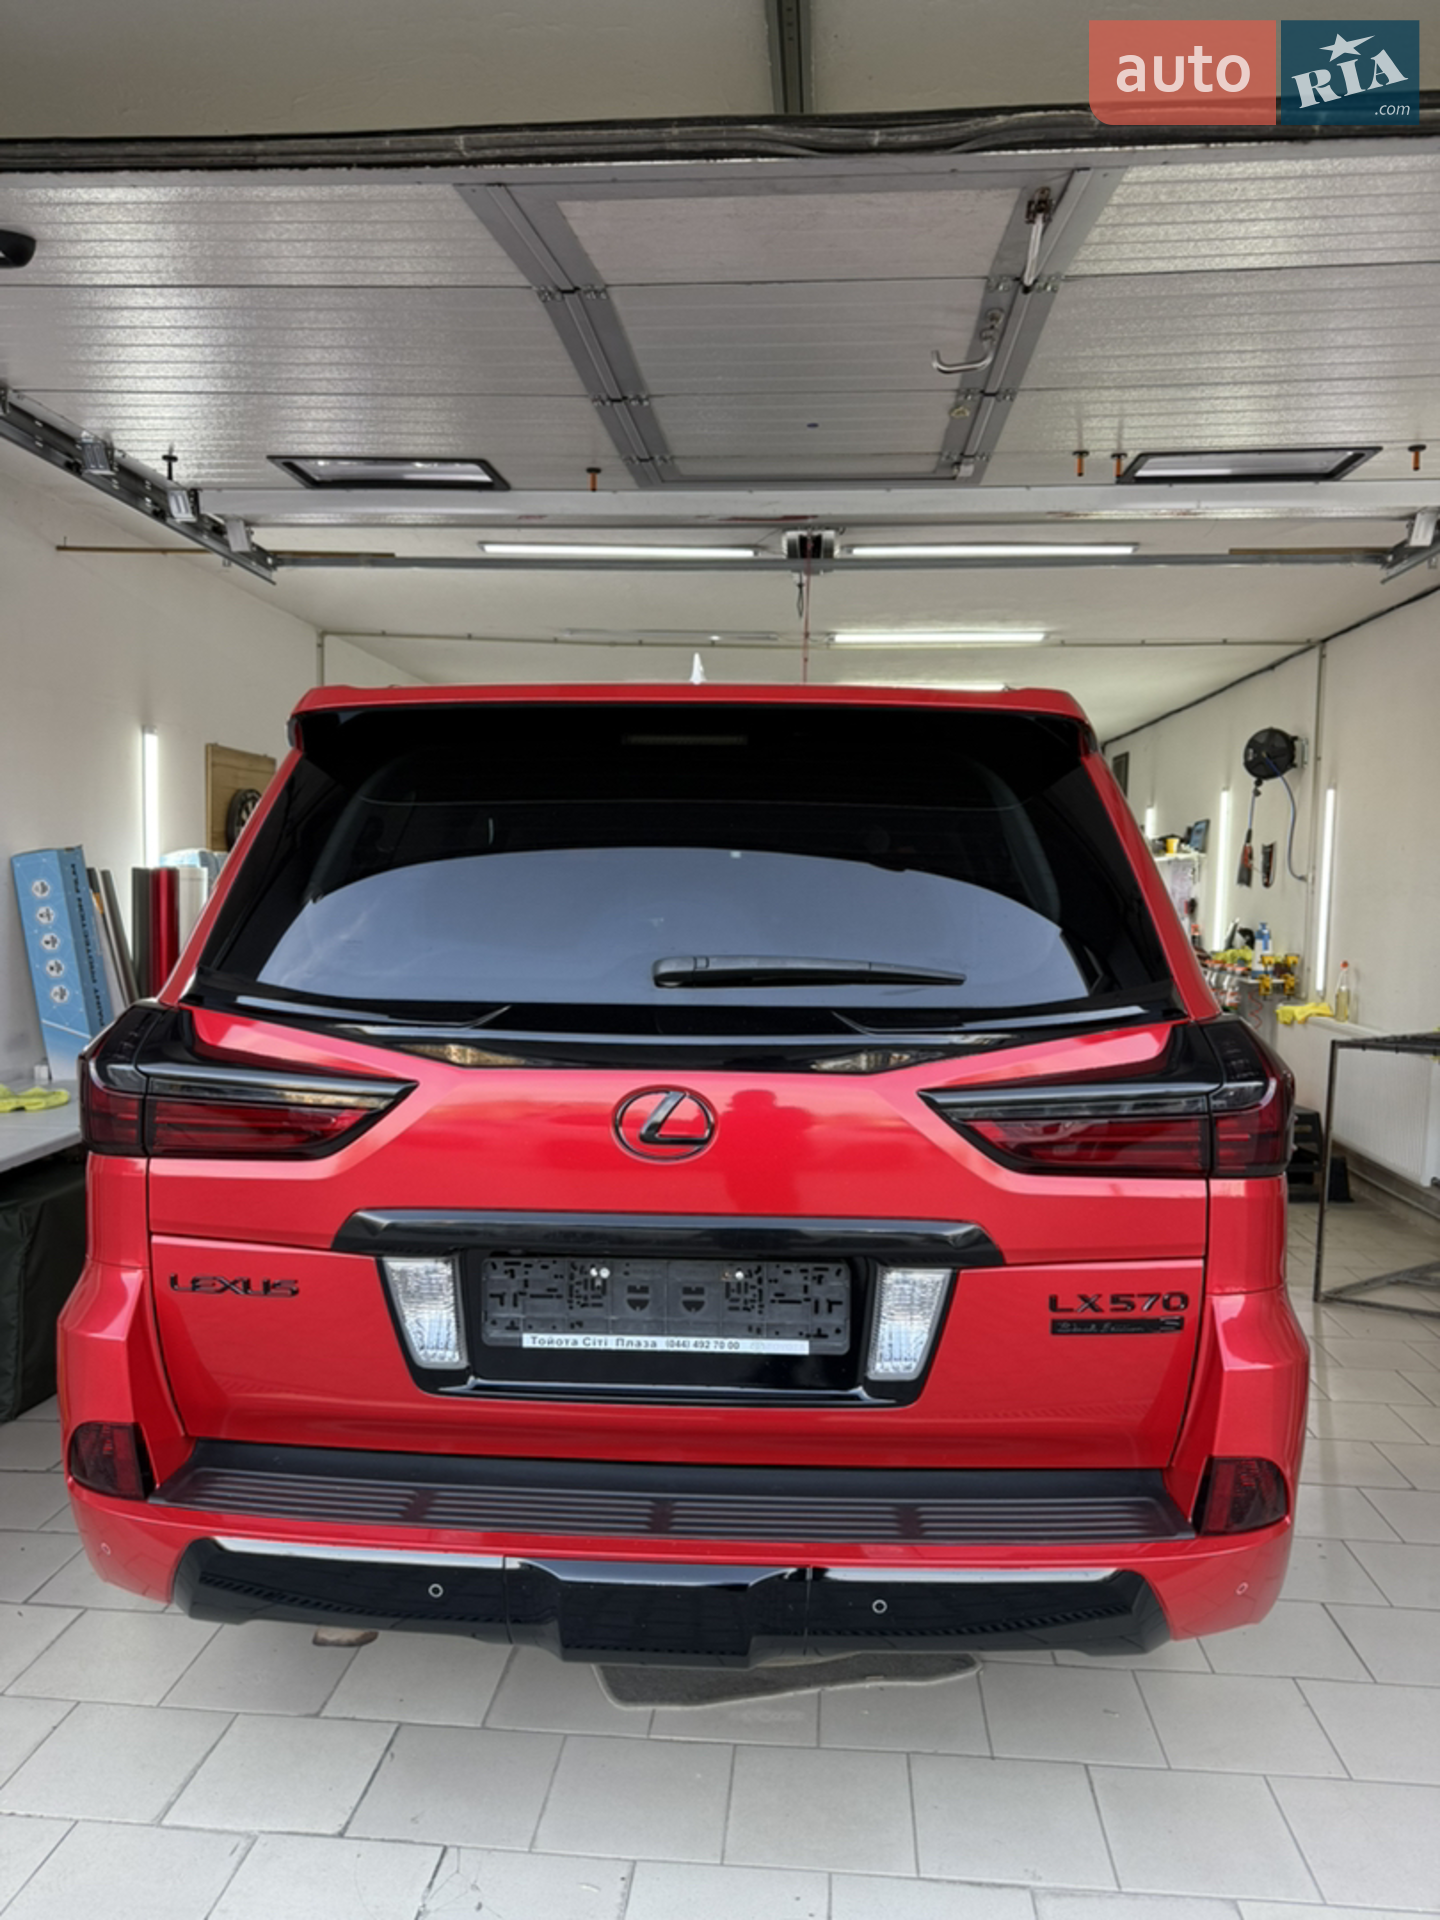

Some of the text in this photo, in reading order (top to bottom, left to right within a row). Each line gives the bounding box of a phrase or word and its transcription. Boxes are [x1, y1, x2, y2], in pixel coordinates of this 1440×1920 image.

[170, 1273, 299, 1298] LEXUS
[1048, 1291, 1190, 1313] LX 570
[530, 1336, 579, 1347] Тойота
[582, 1336, 608, 1347] Сіті
[615, 1337, 658, 1348] Плаза
[693, 1340, 711, 1350] 492
[727, 1340, 740, 1350] 00
